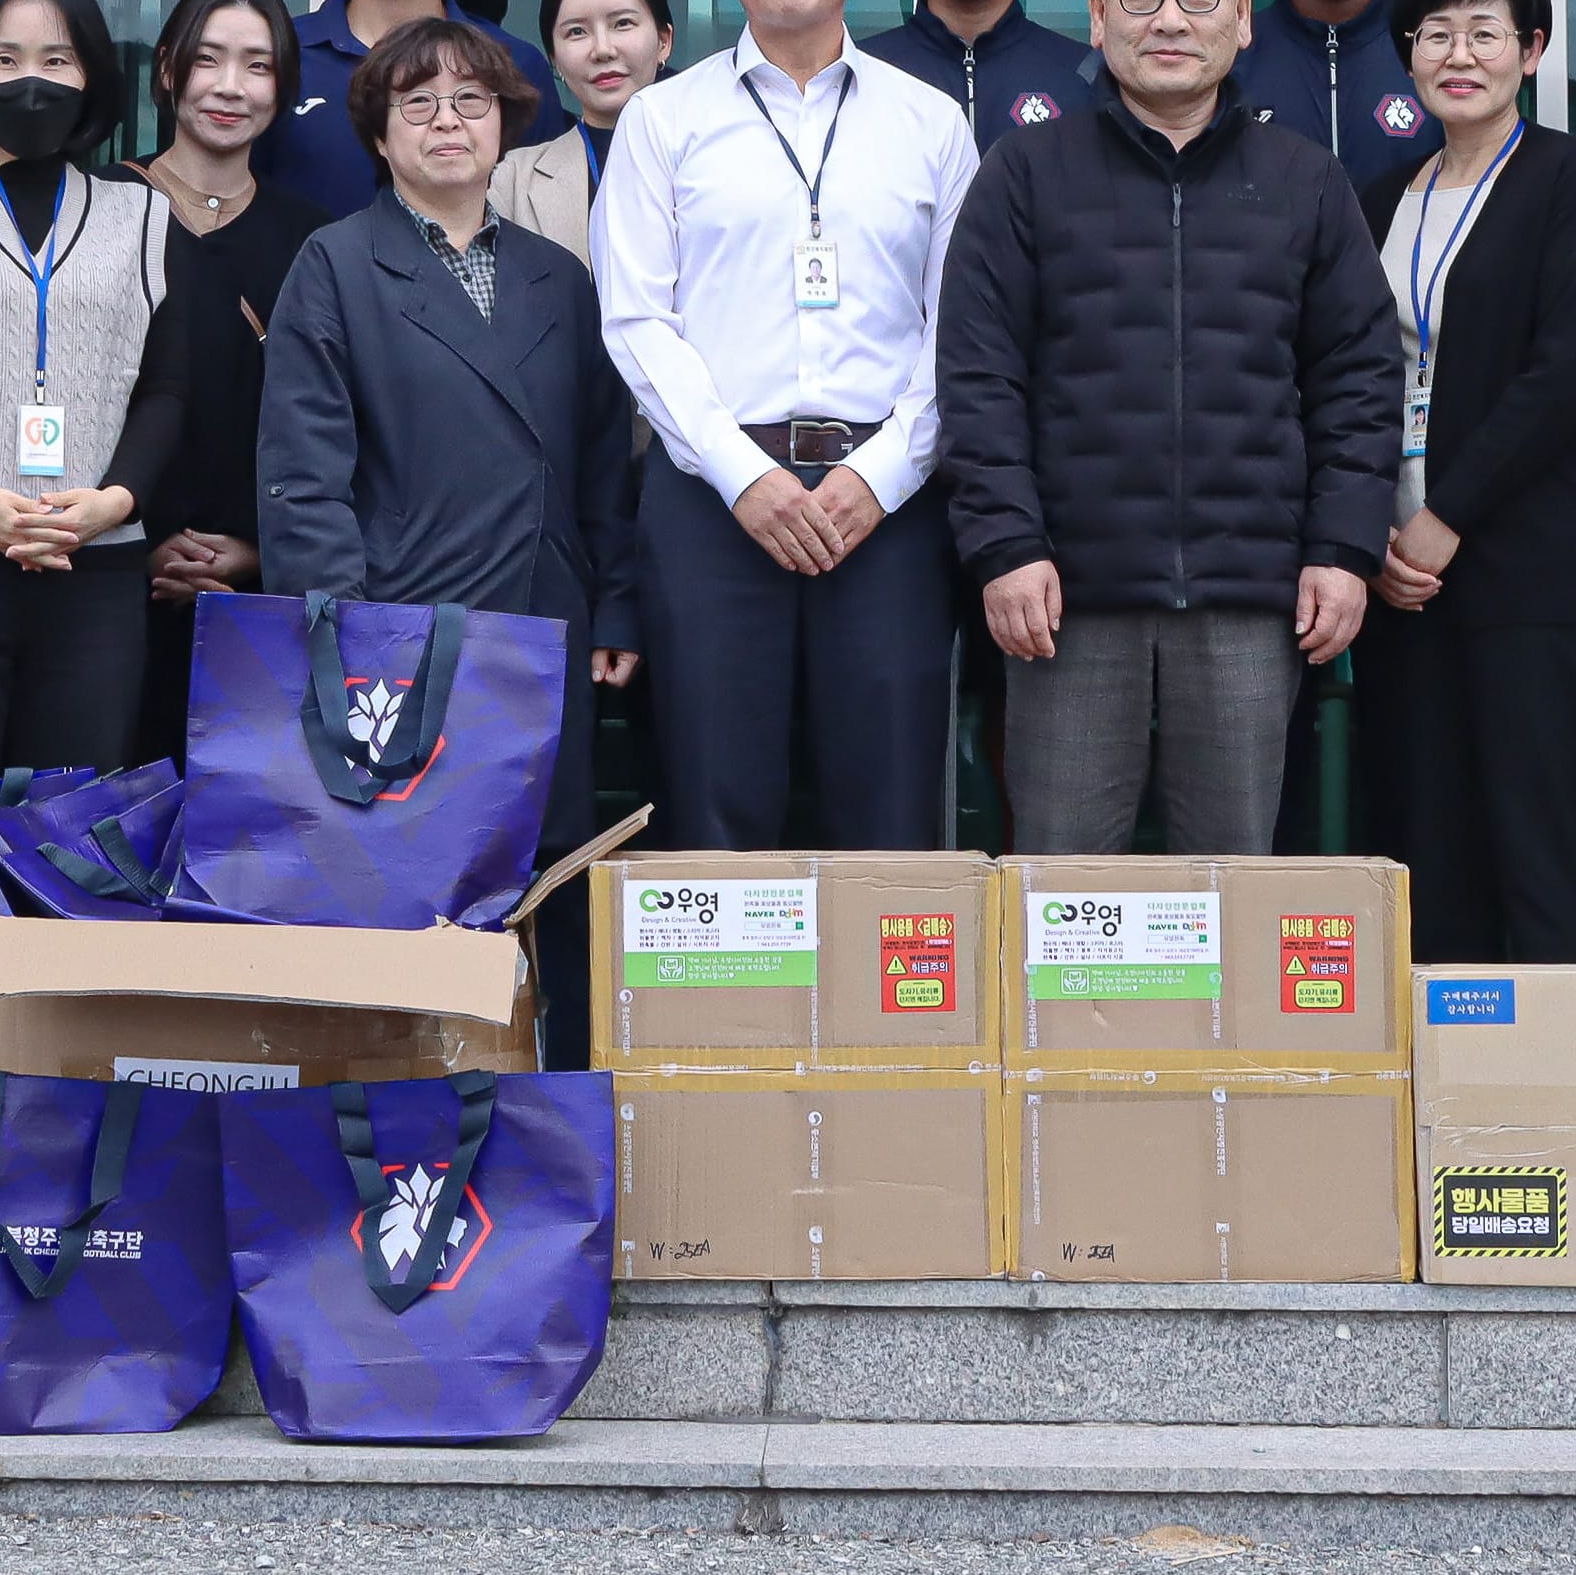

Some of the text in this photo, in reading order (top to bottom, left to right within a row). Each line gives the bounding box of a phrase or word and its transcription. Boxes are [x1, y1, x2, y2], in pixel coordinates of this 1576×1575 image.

[678, 888, 718, 924] 우영
[1082, 900, 1122, 936] 우영
[1451, 1187, 1550, 1214] 행사물품
[1451, 1216, 1550, 1235] 당일배송요청
[83, 1250, 119, 1259] OOTBALL
